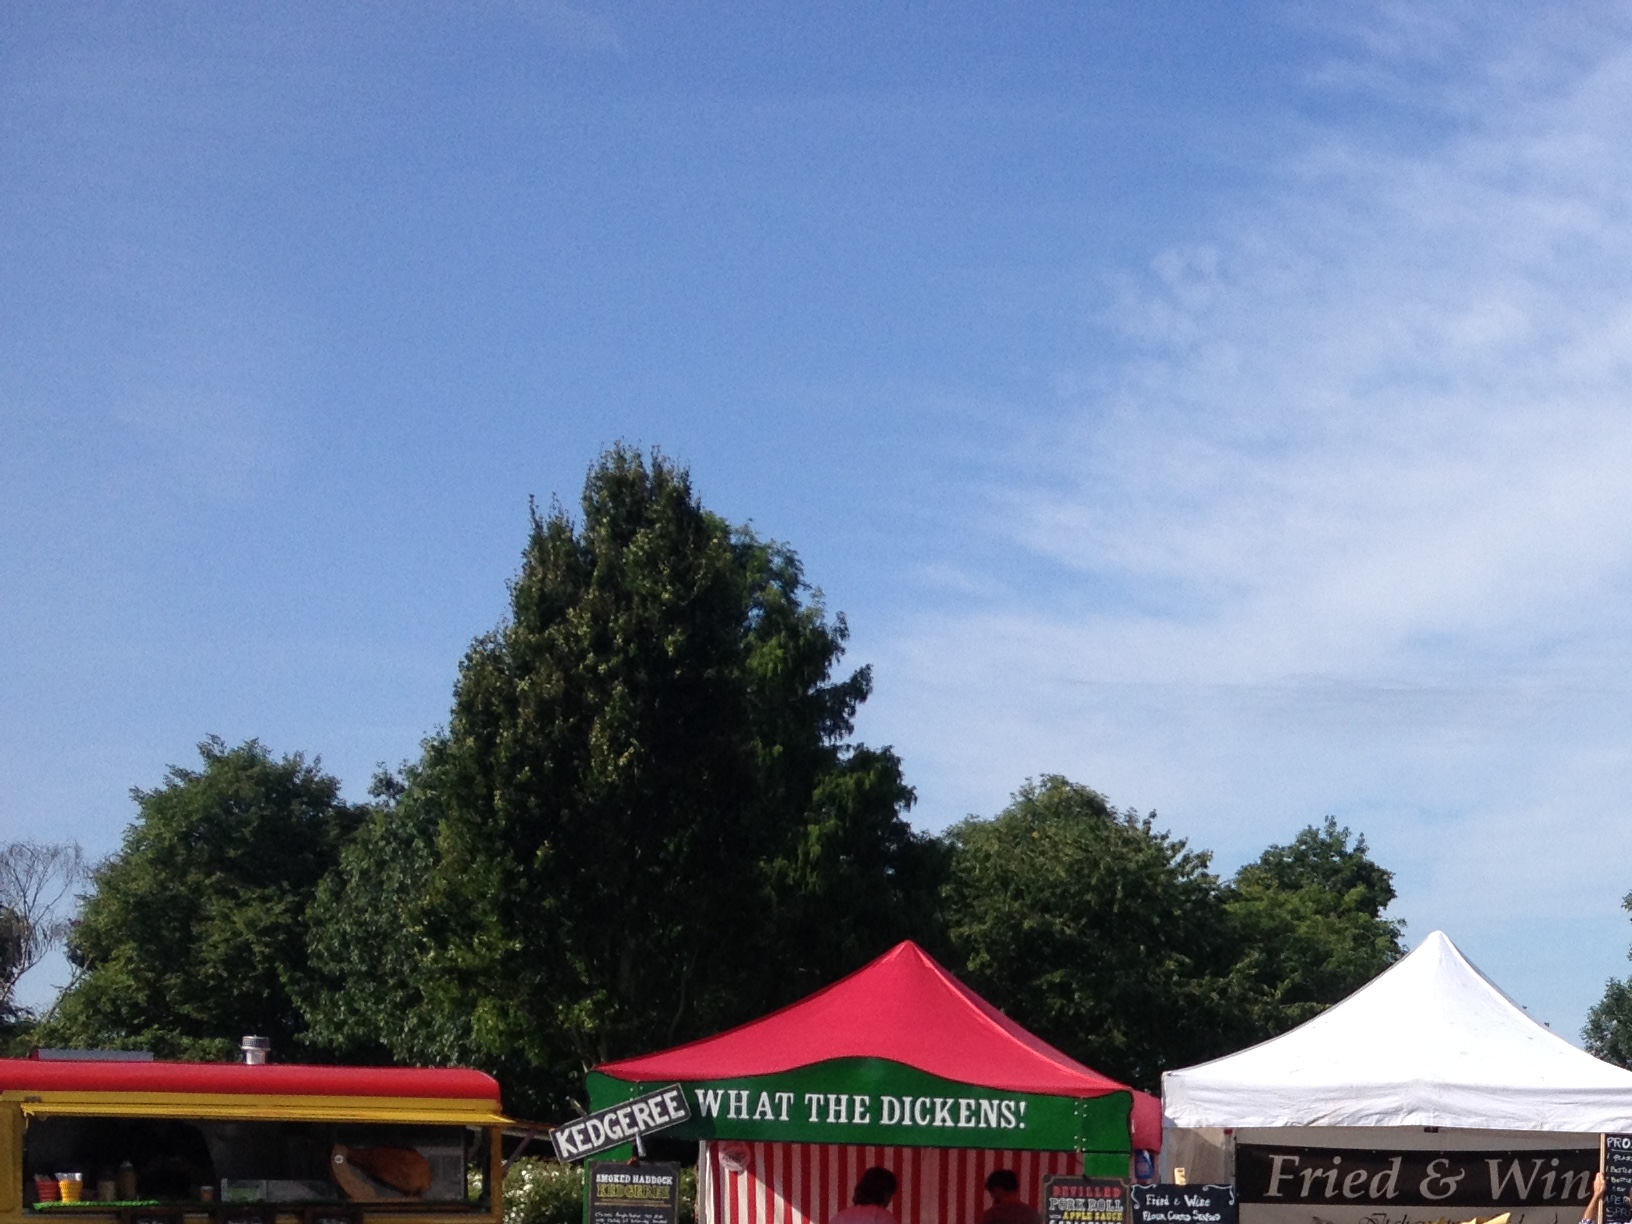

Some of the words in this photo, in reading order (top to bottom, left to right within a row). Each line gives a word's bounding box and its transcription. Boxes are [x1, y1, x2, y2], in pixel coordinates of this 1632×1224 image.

[695, 1089, 795, 1121] WHAT
[804, 1093, 870, 1123] THE
[880, 1096, 1028, 1129] DICKENS!
[555, 1089, 687, 1158] KEDGEREE
[596, 1174, 631, 1184] SMOKED
[632, 1174, 673, 1185] HADDOCK
[1264, 1155, 1402, 1200] Fried
[1419, 1158, 1466, 1200] &
[1485, 1158, 1593, 1201] Win
[1049, 1197, 1086, 1211] PORK
[1088, 1198, 1124, 1212] ROLL
[1145, 1193, 1170, 1206] Fried
[1603, 1194, 1630, 1205] APER
[1063, 1211, 1093, 1220] APPLE
[1094, 1211, 1124, 1221] SAUCE
